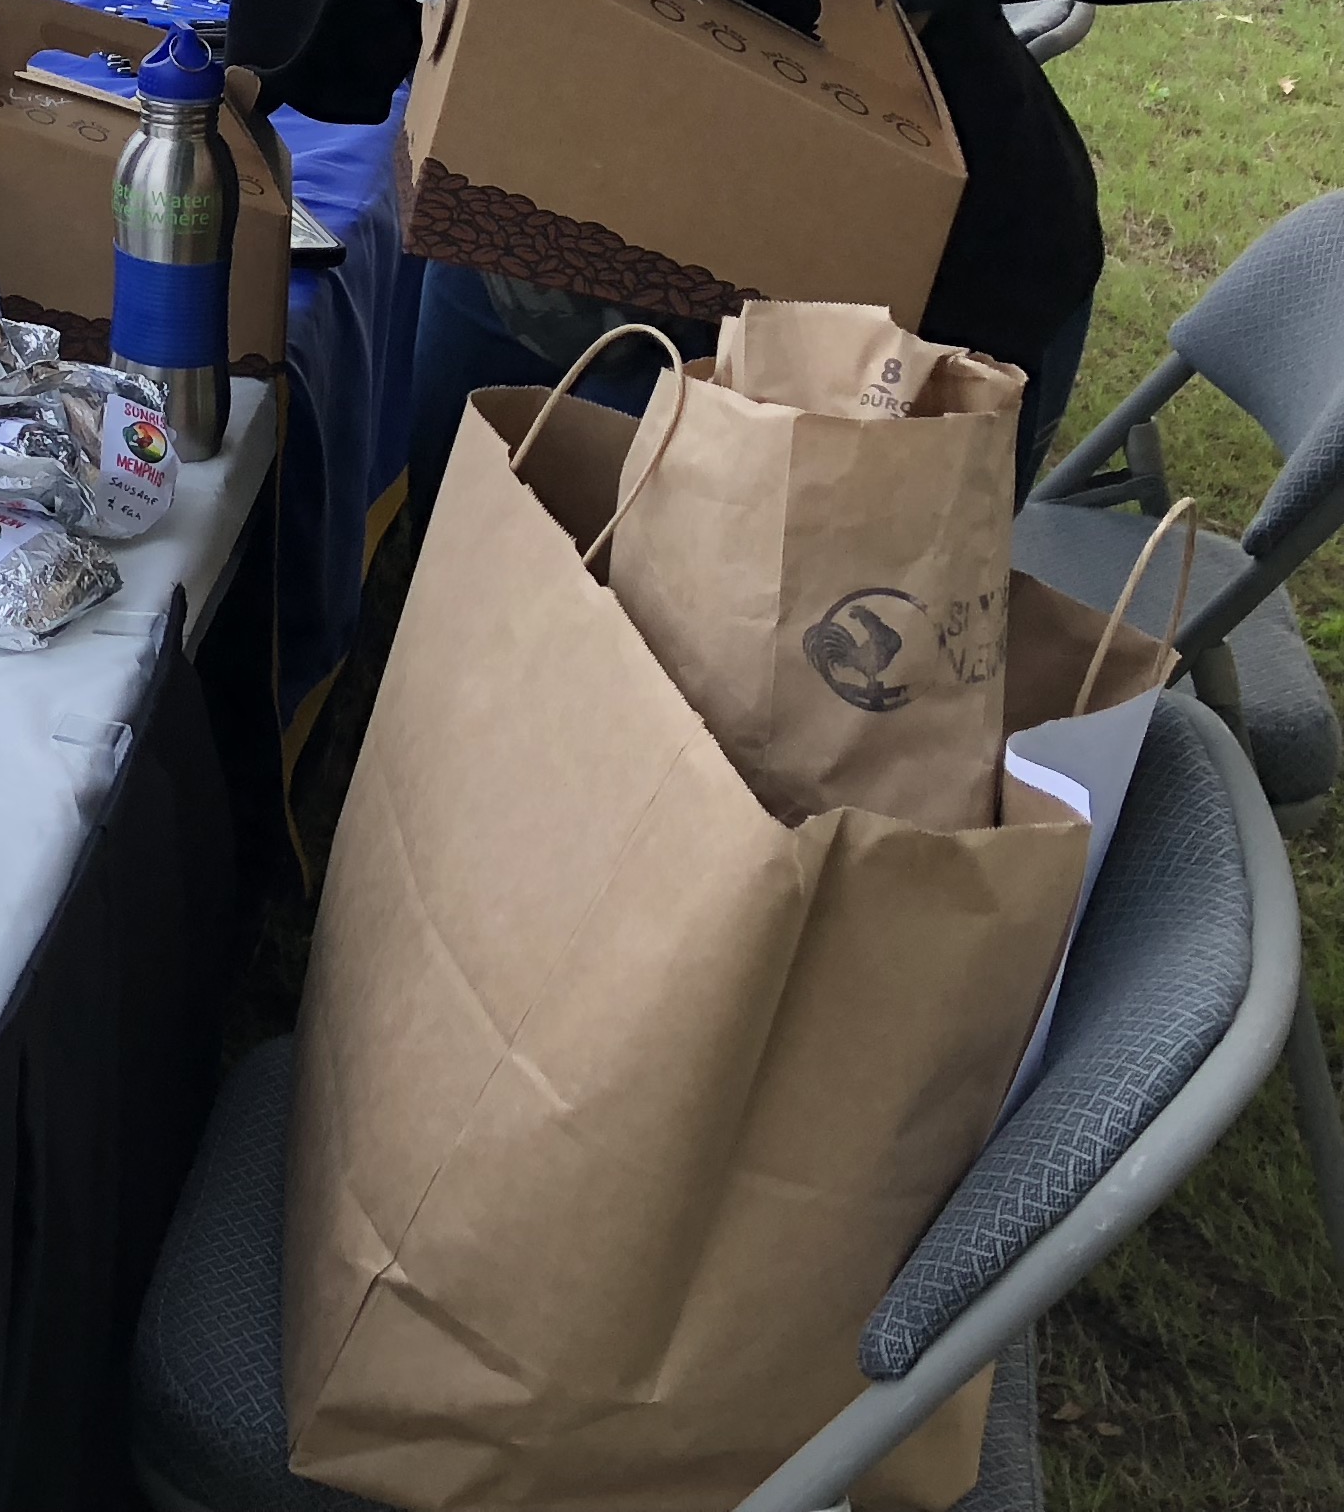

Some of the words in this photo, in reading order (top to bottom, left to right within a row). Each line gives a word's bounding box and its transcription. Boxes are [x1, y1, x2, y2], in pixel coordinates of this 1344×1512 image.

[151, 190, 211, 209] Water
[881, 357, 902, 384] 8
[124, 402, 168, 430] SUNRIS
[860, 393, 914, 416] DURO
[116, 453, 166, 488] MEMPHIS
